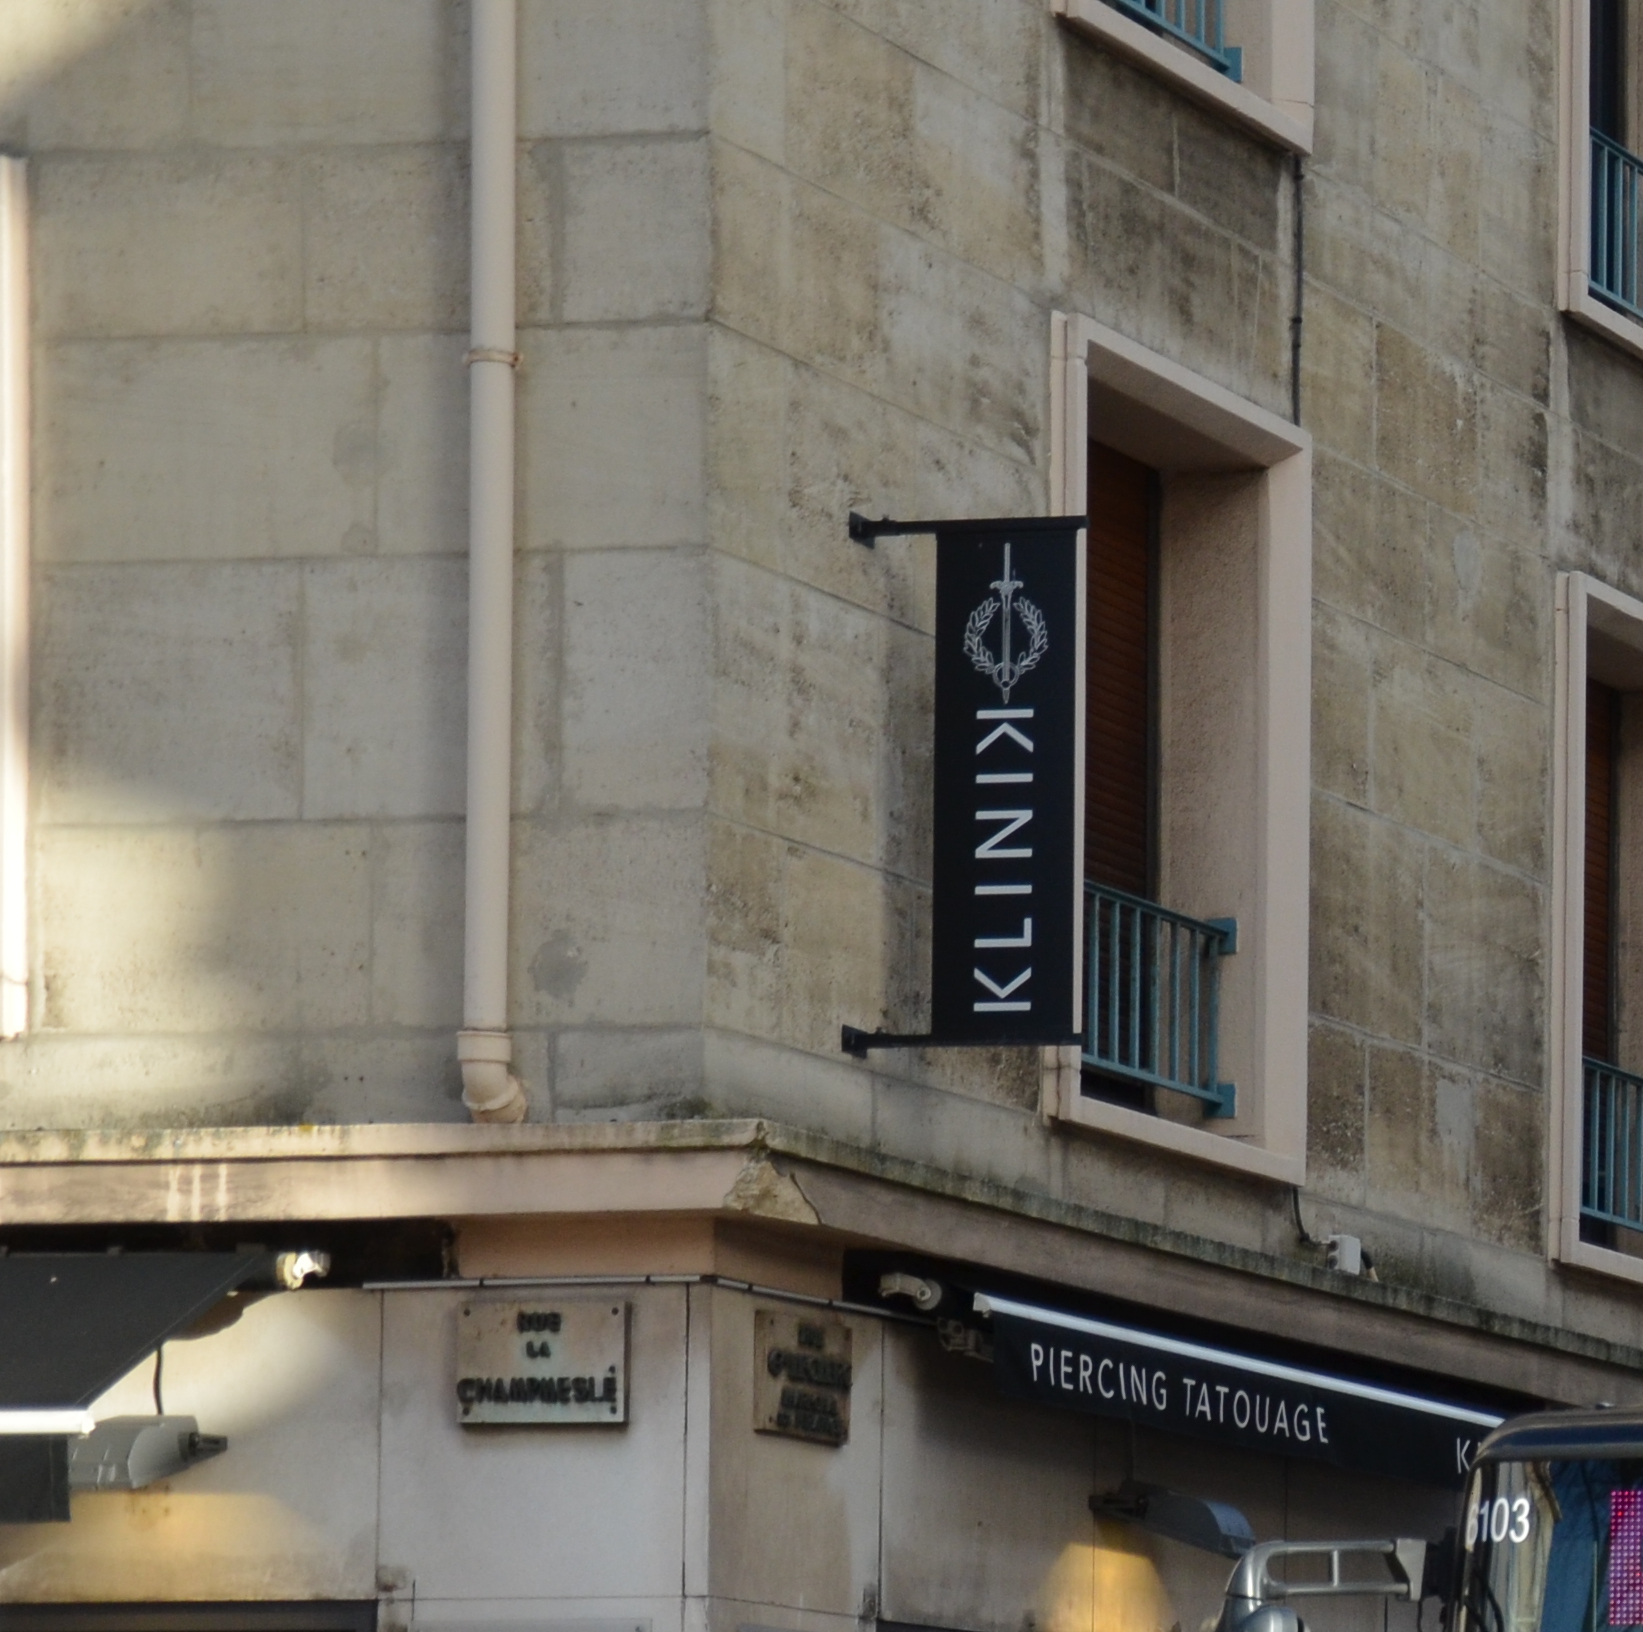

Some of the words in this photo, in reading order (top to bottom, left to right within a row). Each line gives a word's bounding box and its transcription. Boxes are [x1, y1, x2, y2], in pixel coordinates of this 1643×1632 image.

[973, 708, 1034, 1012] KLINIK
[516, 1312, 562, 1333] RUE
[525, 1341, 551, 1358] LA
[1029, 1342, 1168, 1411] PIERCING
[1182, 1377, 1330, 1445] TATOUAGE
[1465, 1497, 1530, 1546] 6103
